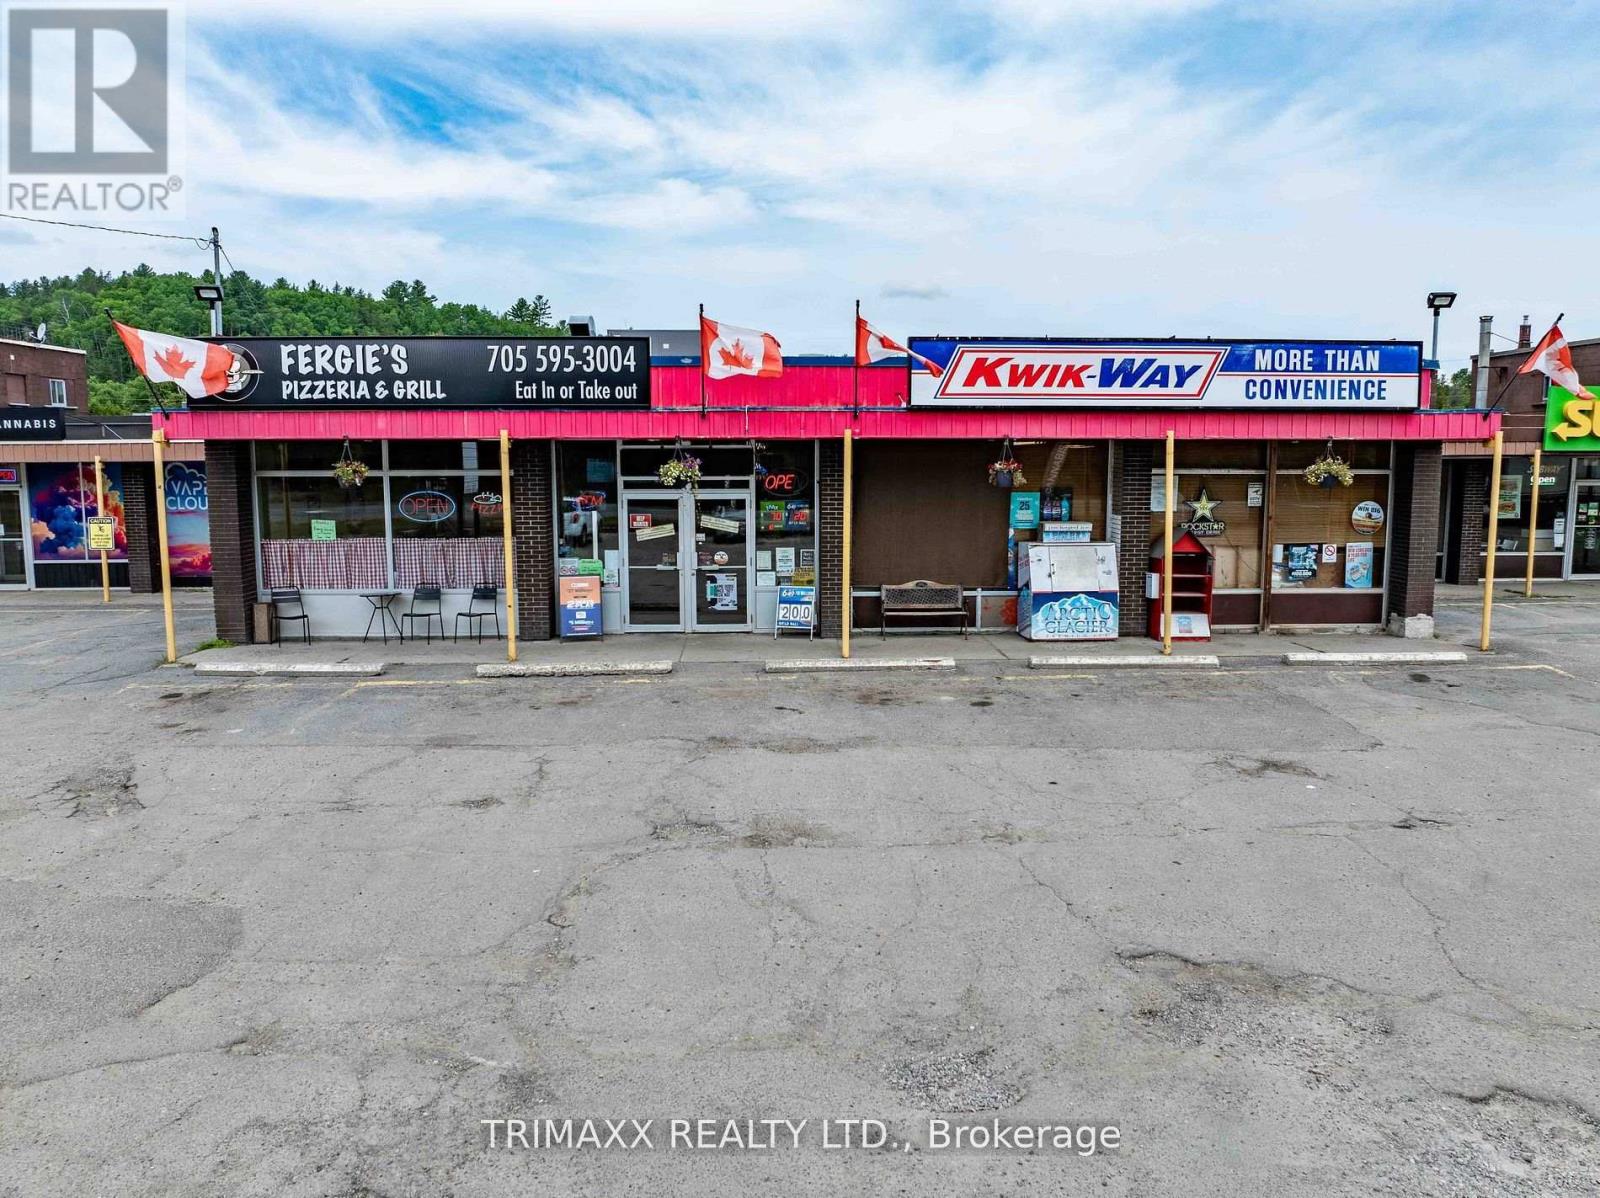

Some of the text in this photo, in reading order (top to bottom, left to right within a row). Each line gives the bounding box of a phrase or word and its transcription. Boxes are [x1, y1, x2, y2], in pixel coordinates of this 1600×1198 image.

[280, 344, 409, 375] FERGIE'S
[487, 345, 636, 373] 705 595-3004
[1255, 349, 1380, 371] MORE THAN
[282, 380, 447, 400] PIZZERIA & GRILL
[515, 379, 638, 399] Eat In or Take out
[1245, 378, 1387, 400] CONVENIENCE
[403, 497, 449, 515] OPEN
[1019, 501, 1030, 511] 25
[1357, 505, 1369, 513] WIN
[1045, 602, 1111, 621] ARCTIC
[1045, 620, 1111, 633] GLACIER
